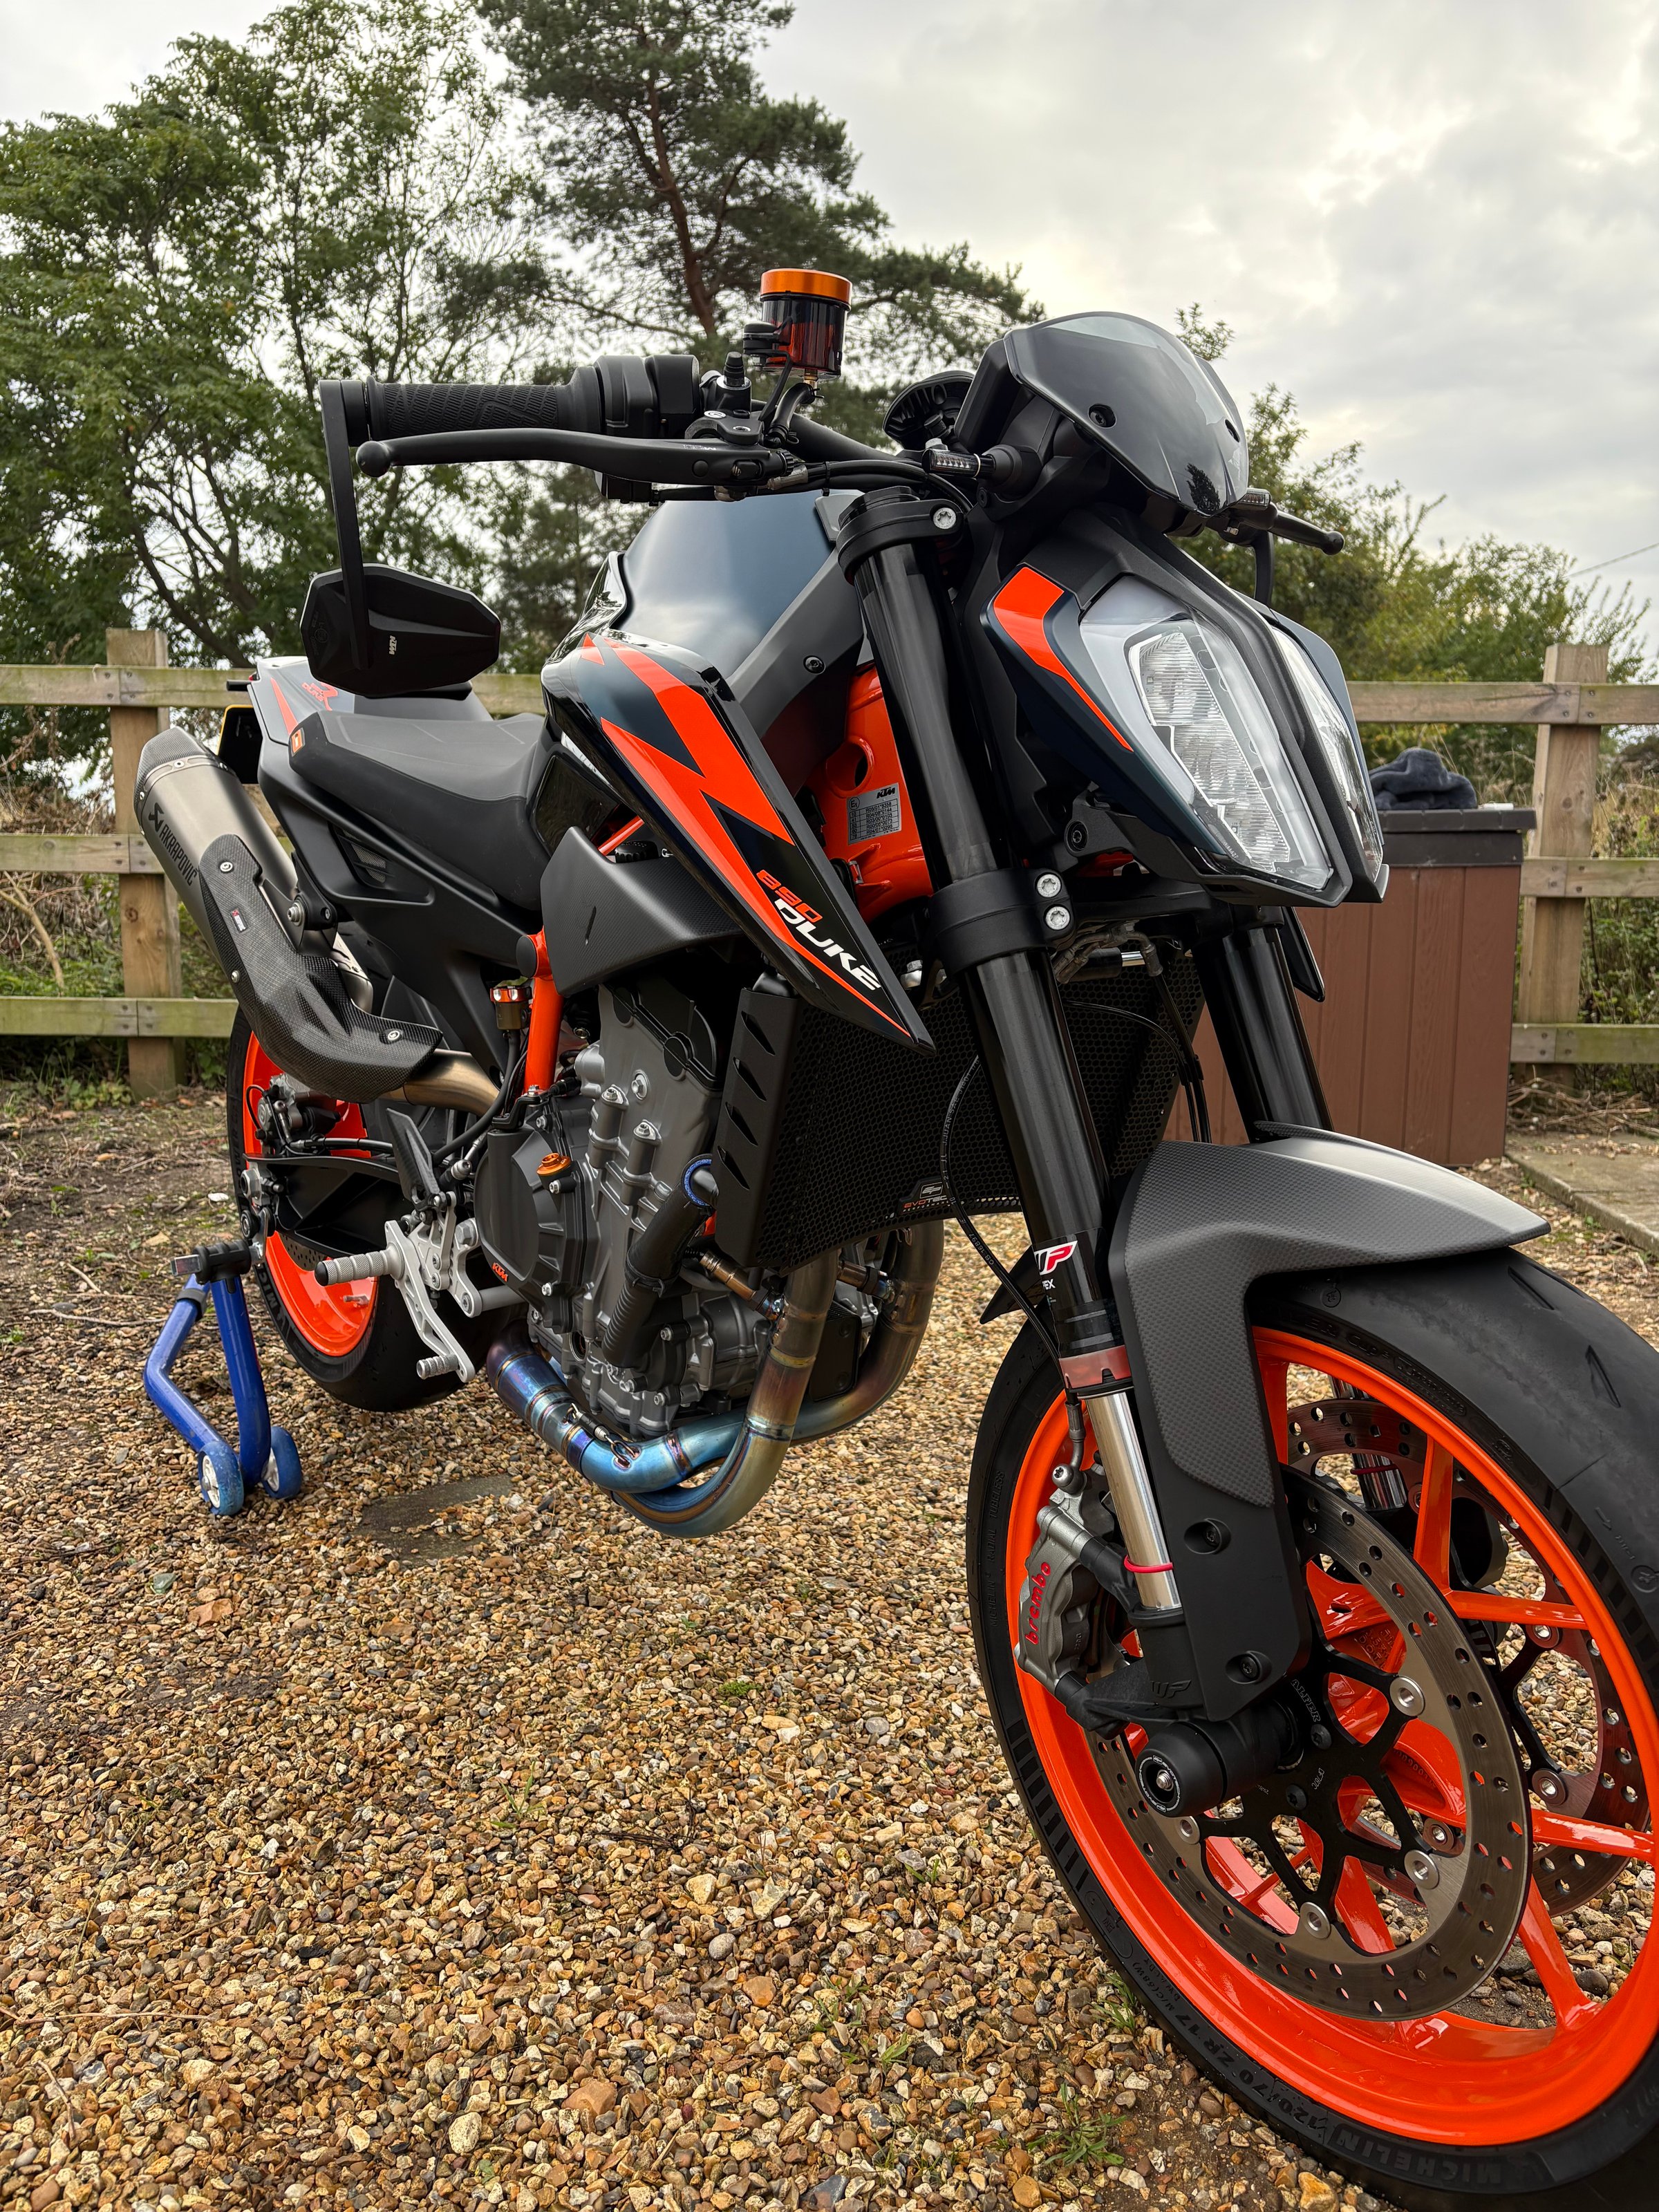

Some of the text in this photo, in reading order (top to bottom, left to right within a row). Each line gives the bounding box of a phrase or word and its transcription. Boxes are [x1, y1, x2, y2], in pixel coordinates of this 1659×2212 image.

[388, 635, 397, 655] KTM
[877, 787, 896, 799] KTM
[756, 870, 823, 923] 890
[774, 899, 882, 990] DUKE
[904, 1195, 948, 1208] EVOTEC
[492, 1262, 509, 1282] KTM
[1025, 1561, 1051, 1645] brembo
[1291, 1679, 1322, 1723] ALFER
[1239, 2069, 1322, 2129] 120/70
[1337, 2128, 1501, 2185] MICHELIN
